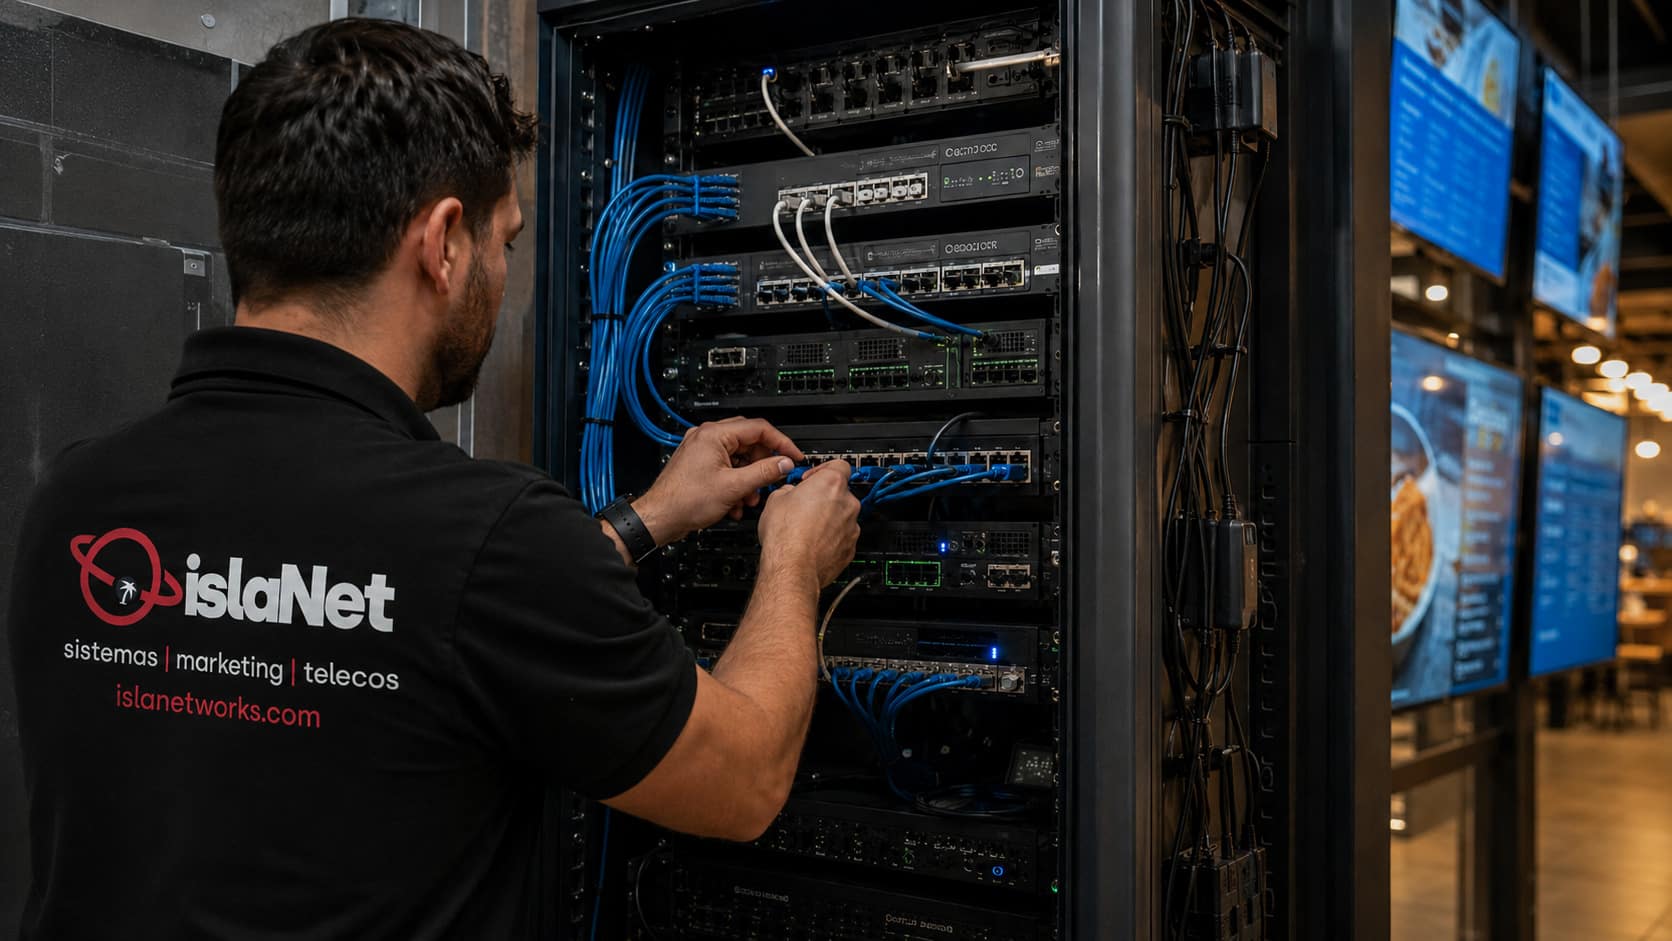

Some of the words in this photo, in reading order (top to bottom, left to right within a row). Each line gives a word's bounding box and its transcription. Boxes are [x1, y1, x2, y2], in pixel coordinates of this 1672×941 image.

[185, 553, 396, 633] islaNet
[64, 639, 159, 667] sistemas
[176, 651, 284, 687] marketing
[303, 661, 400, 691] telecos
[116, 684, 321, 729] islanetworks.com
